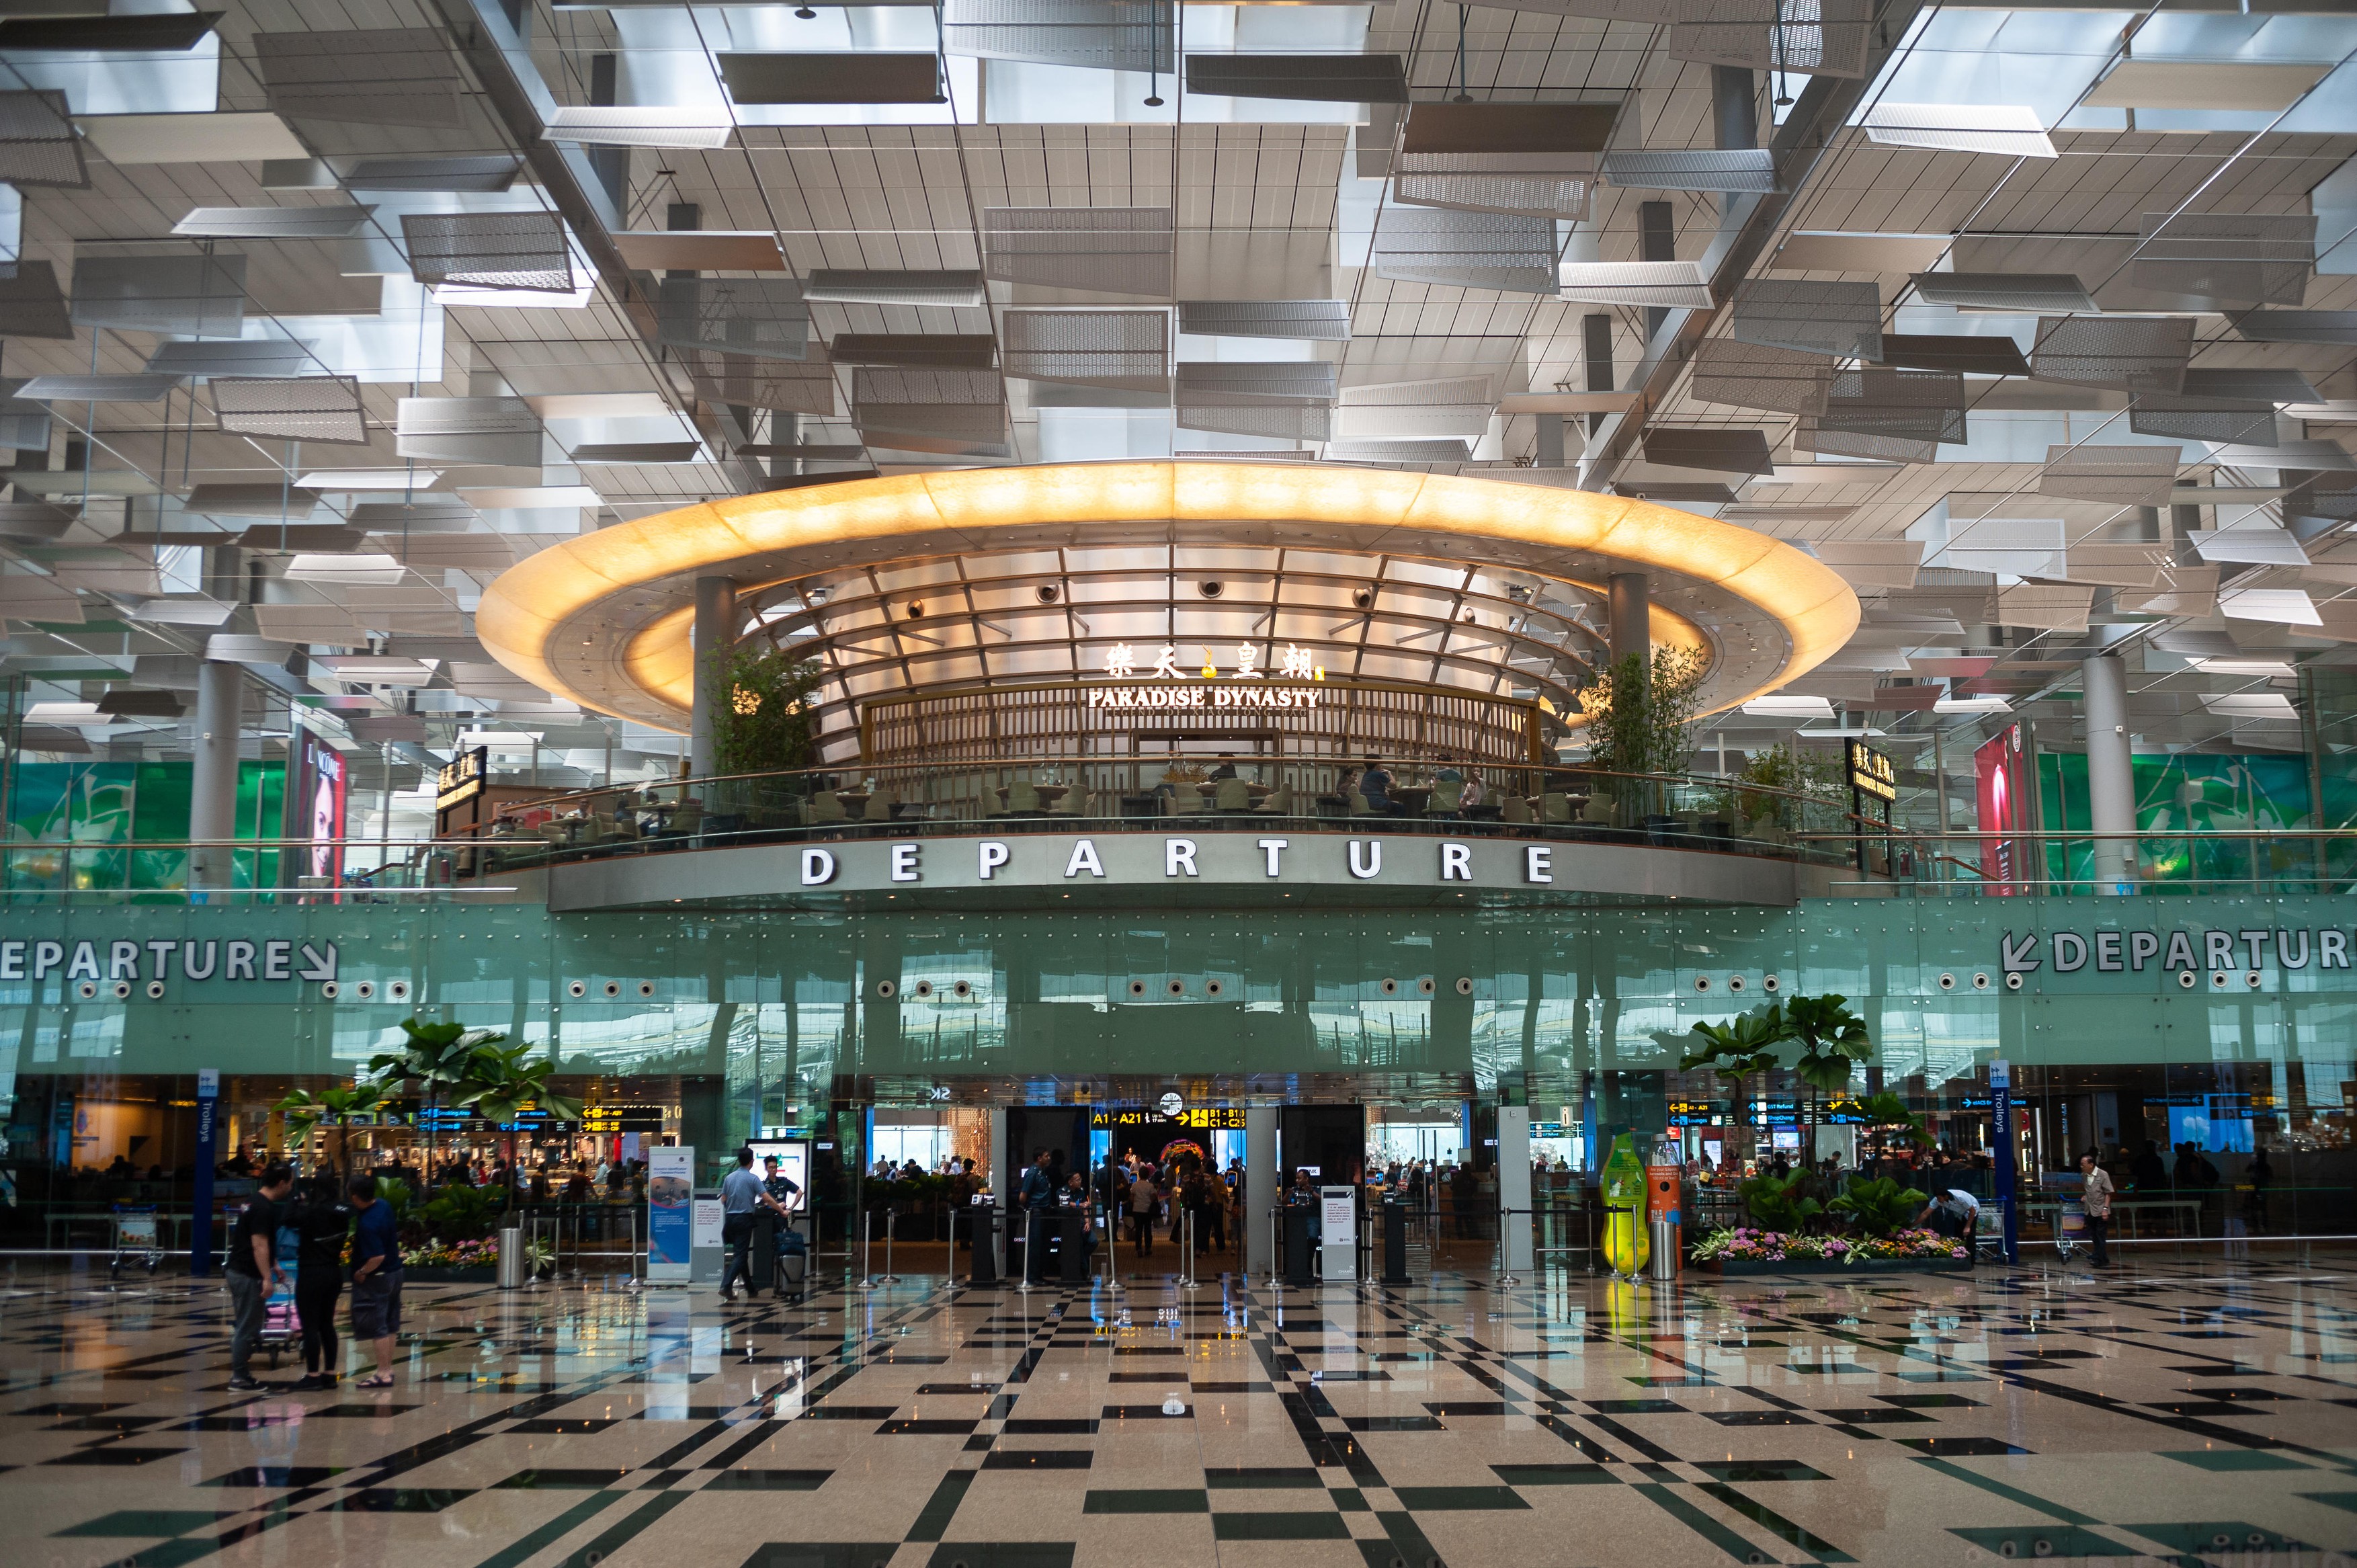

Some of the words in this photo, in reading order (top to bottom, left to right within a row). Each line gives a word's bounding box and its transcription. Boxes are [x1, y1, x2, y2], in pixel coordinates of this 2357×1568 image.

[1103, 641, 1313, 681] 樂天皇朝
[1088, 690, 1206, 708] PARADISE
[1213, 690, 1321, 708] DYNASTY
[1106, 708, 1155, 716] LEGEND
[1167, 708, 1180, 716] OF
[1282, 709, 1307, 717] BAO
[308, 743, 341, 781] LNCÔME
[801, 837, 1553, 885] DEPARTURE
[0, 941, 291, 980] EPARTURE
[2052, 930, 2357, 971] DEPARTUR
[199, 1101, 213, 1143] Trolleys
[1093, 1113, 1108, 1124] A1
[1119, 1113, 1141, 1124] A21
[1210, 1109, 1220, 1117] B1
[1210, 1118, 1220, 1127] C1
[1995, 1091, 2004, 1133] Trolleys
